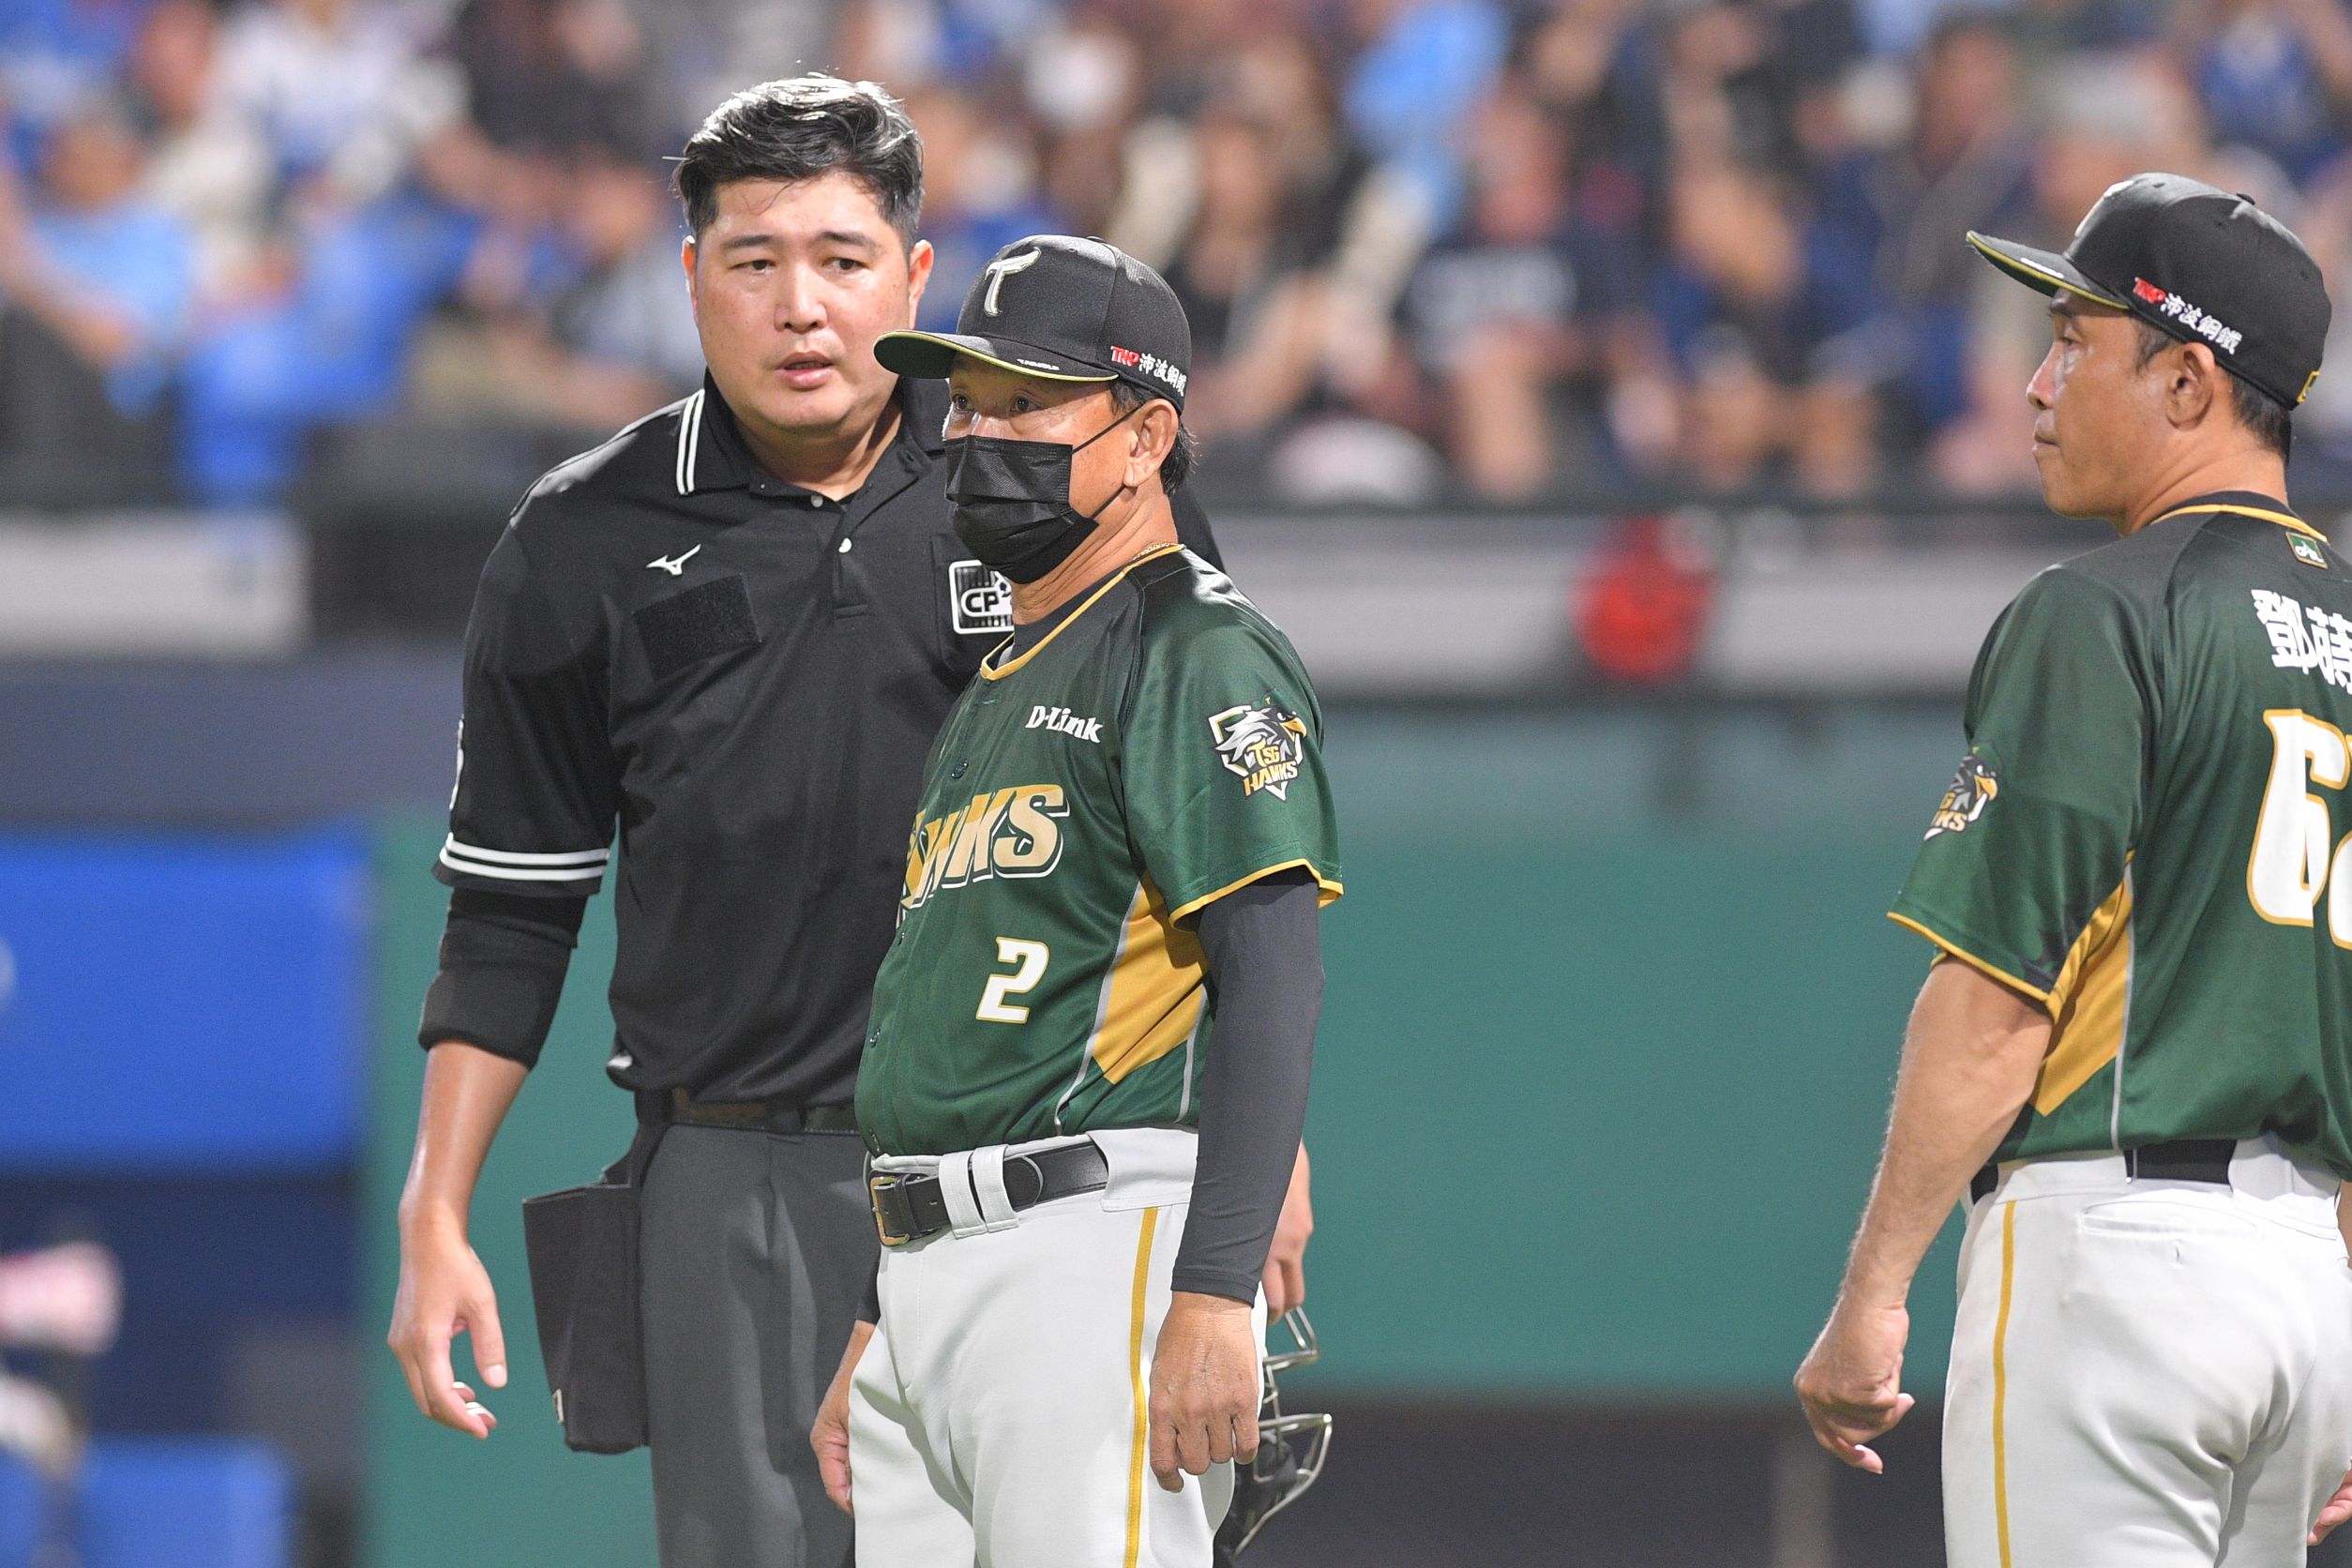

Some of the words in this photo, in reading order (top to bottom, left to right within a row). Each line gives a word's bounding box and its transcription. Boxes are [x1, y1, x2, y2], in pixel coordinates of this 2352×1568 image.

[985, 247, 1042, 317] T
[1025, 705, 1103, 744] D-Link
[1246, 737, 1280, 768] TSG
[1243, 761, 1298, 796] HAWKS
[1931, 809, 1968, 832] KS
[2246, 709, 2352, 950] 6
[975, 936, 1049, 1024] 2
